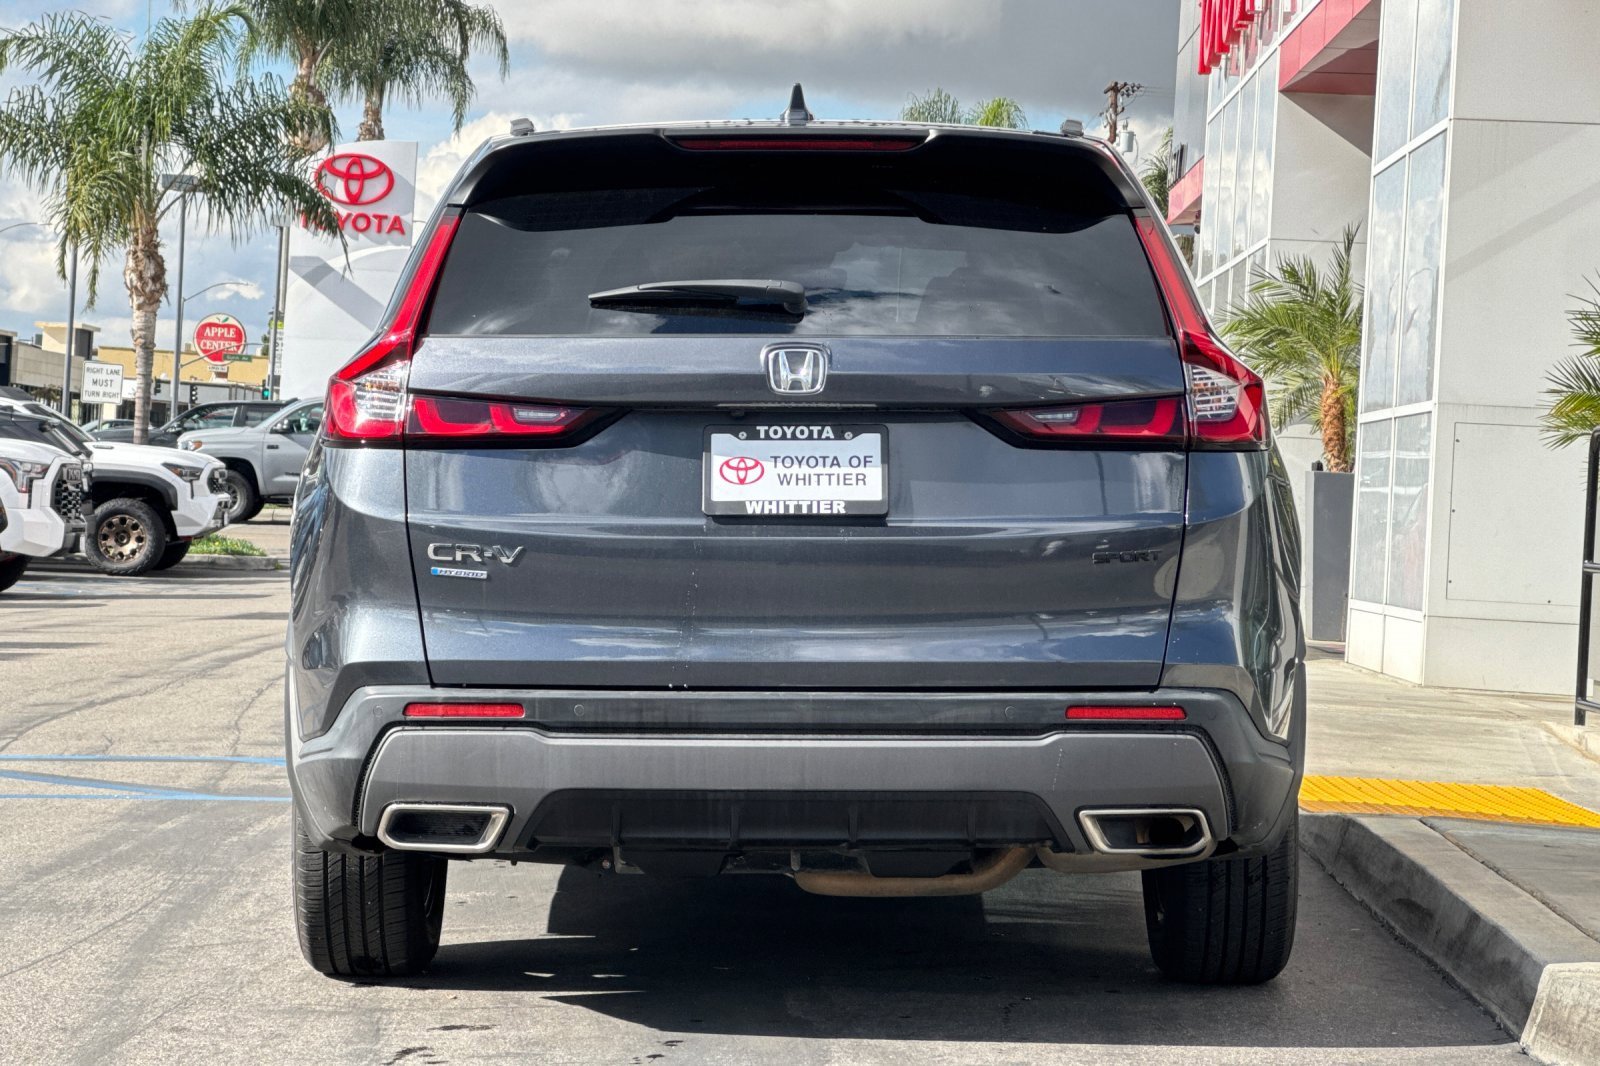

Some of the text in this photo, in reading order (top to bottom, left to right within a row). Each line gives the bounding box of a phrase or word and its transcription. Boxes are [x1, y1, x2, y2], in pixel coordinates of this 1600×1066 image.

[203, 326, 236, 338] APPLE
[200, 339, 238, 352] CENTER
[86, 366, 121, 376] RIGHT LANE
[91, 378, 114, 388] MUST
[84, 390, 120, 399] TURN RIGHT
[756, 425, 835, 440] TOYOTA
[770, 455, 873, 469] TOYOTA OF
[777, 472, 868, 487] WHITTIER
[745, 499, 846, 515] WHITTIER
[427, 542, 524, 564] CR-V
[438, 568, 485, 578] HYBRID
